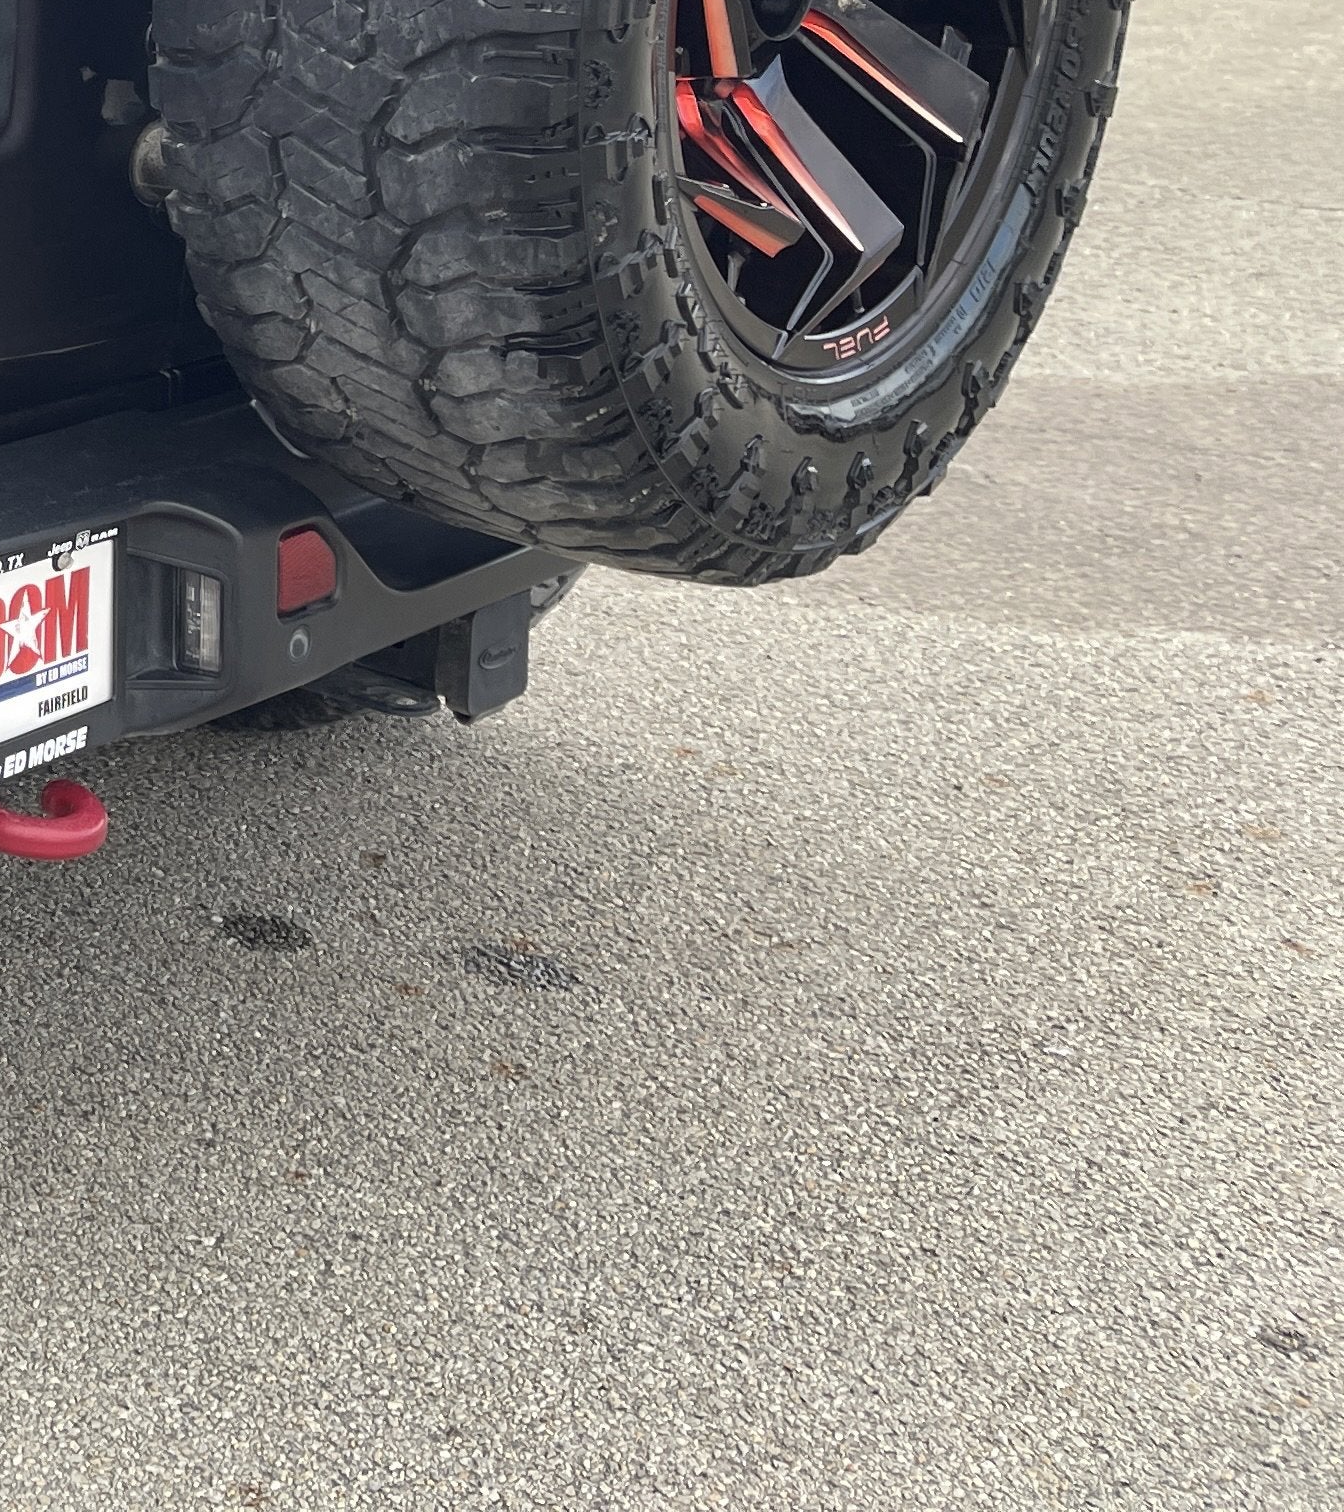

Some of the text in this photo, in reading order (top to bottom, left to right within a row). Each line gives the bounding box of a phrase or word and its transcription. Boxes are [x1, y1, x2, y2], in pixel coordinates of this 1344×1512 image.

[823, 315, 891, 360] FUEL
[48, 541, 73, 557] Jeep
[91, 527, 119, 543] RAM
[6, 553, 25, 571] TX
[35, 657, 88, 687] BY ED MORSE
[38, 685, 88, 718] FAIRFIELD
[2, 749, 27, 778] ED
[27, 725, 88, 769] MORSE
